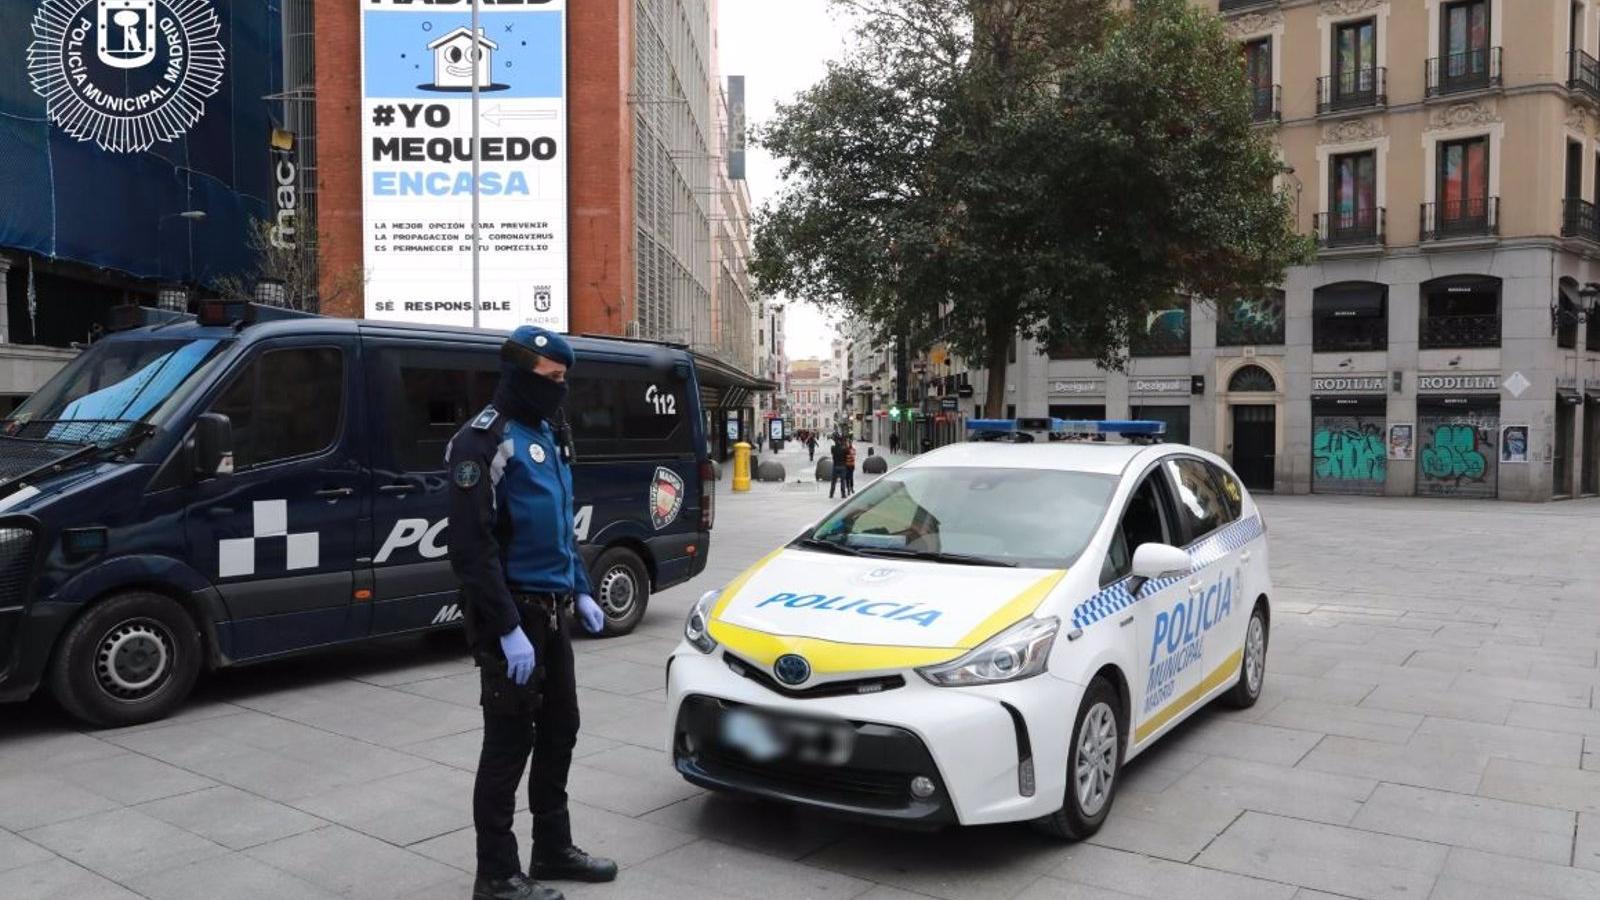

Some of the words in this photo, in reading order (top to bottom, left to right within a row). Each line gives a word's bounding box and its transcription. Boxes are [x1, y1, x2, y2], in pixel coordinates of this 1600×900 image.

[372, 104, 450, 128] #YO
[372, 136, 557, 163] MEQUEDO
[372, 171, 530, 196] ENCASA
[374, 222, 387, 230] LA
[392, 222, 423, 230] MEJOR
[500, 221, 548, 229] PREVENIR
[374, 233, 387, 241] LA
[488, 232, 554, 240] CORONAVIRUS
[374, 244, 387, 252] ES
[392, 244, 453, 252] PERMANECER
[458, 244, 471, 252] EN
[404, 301, 511, 311] RESPONSBLE
[1314, 379, 1384, 391] RODILLA
[1421, 376, 1496, 389] RODILLA
[652, 394, 676, 415] 112
[755, 592, 943, 627] POLICÍA
[1151, 571, 1232, 665] POLICÍA
[1147, 636, 1204, 693] MUNICIPAL
